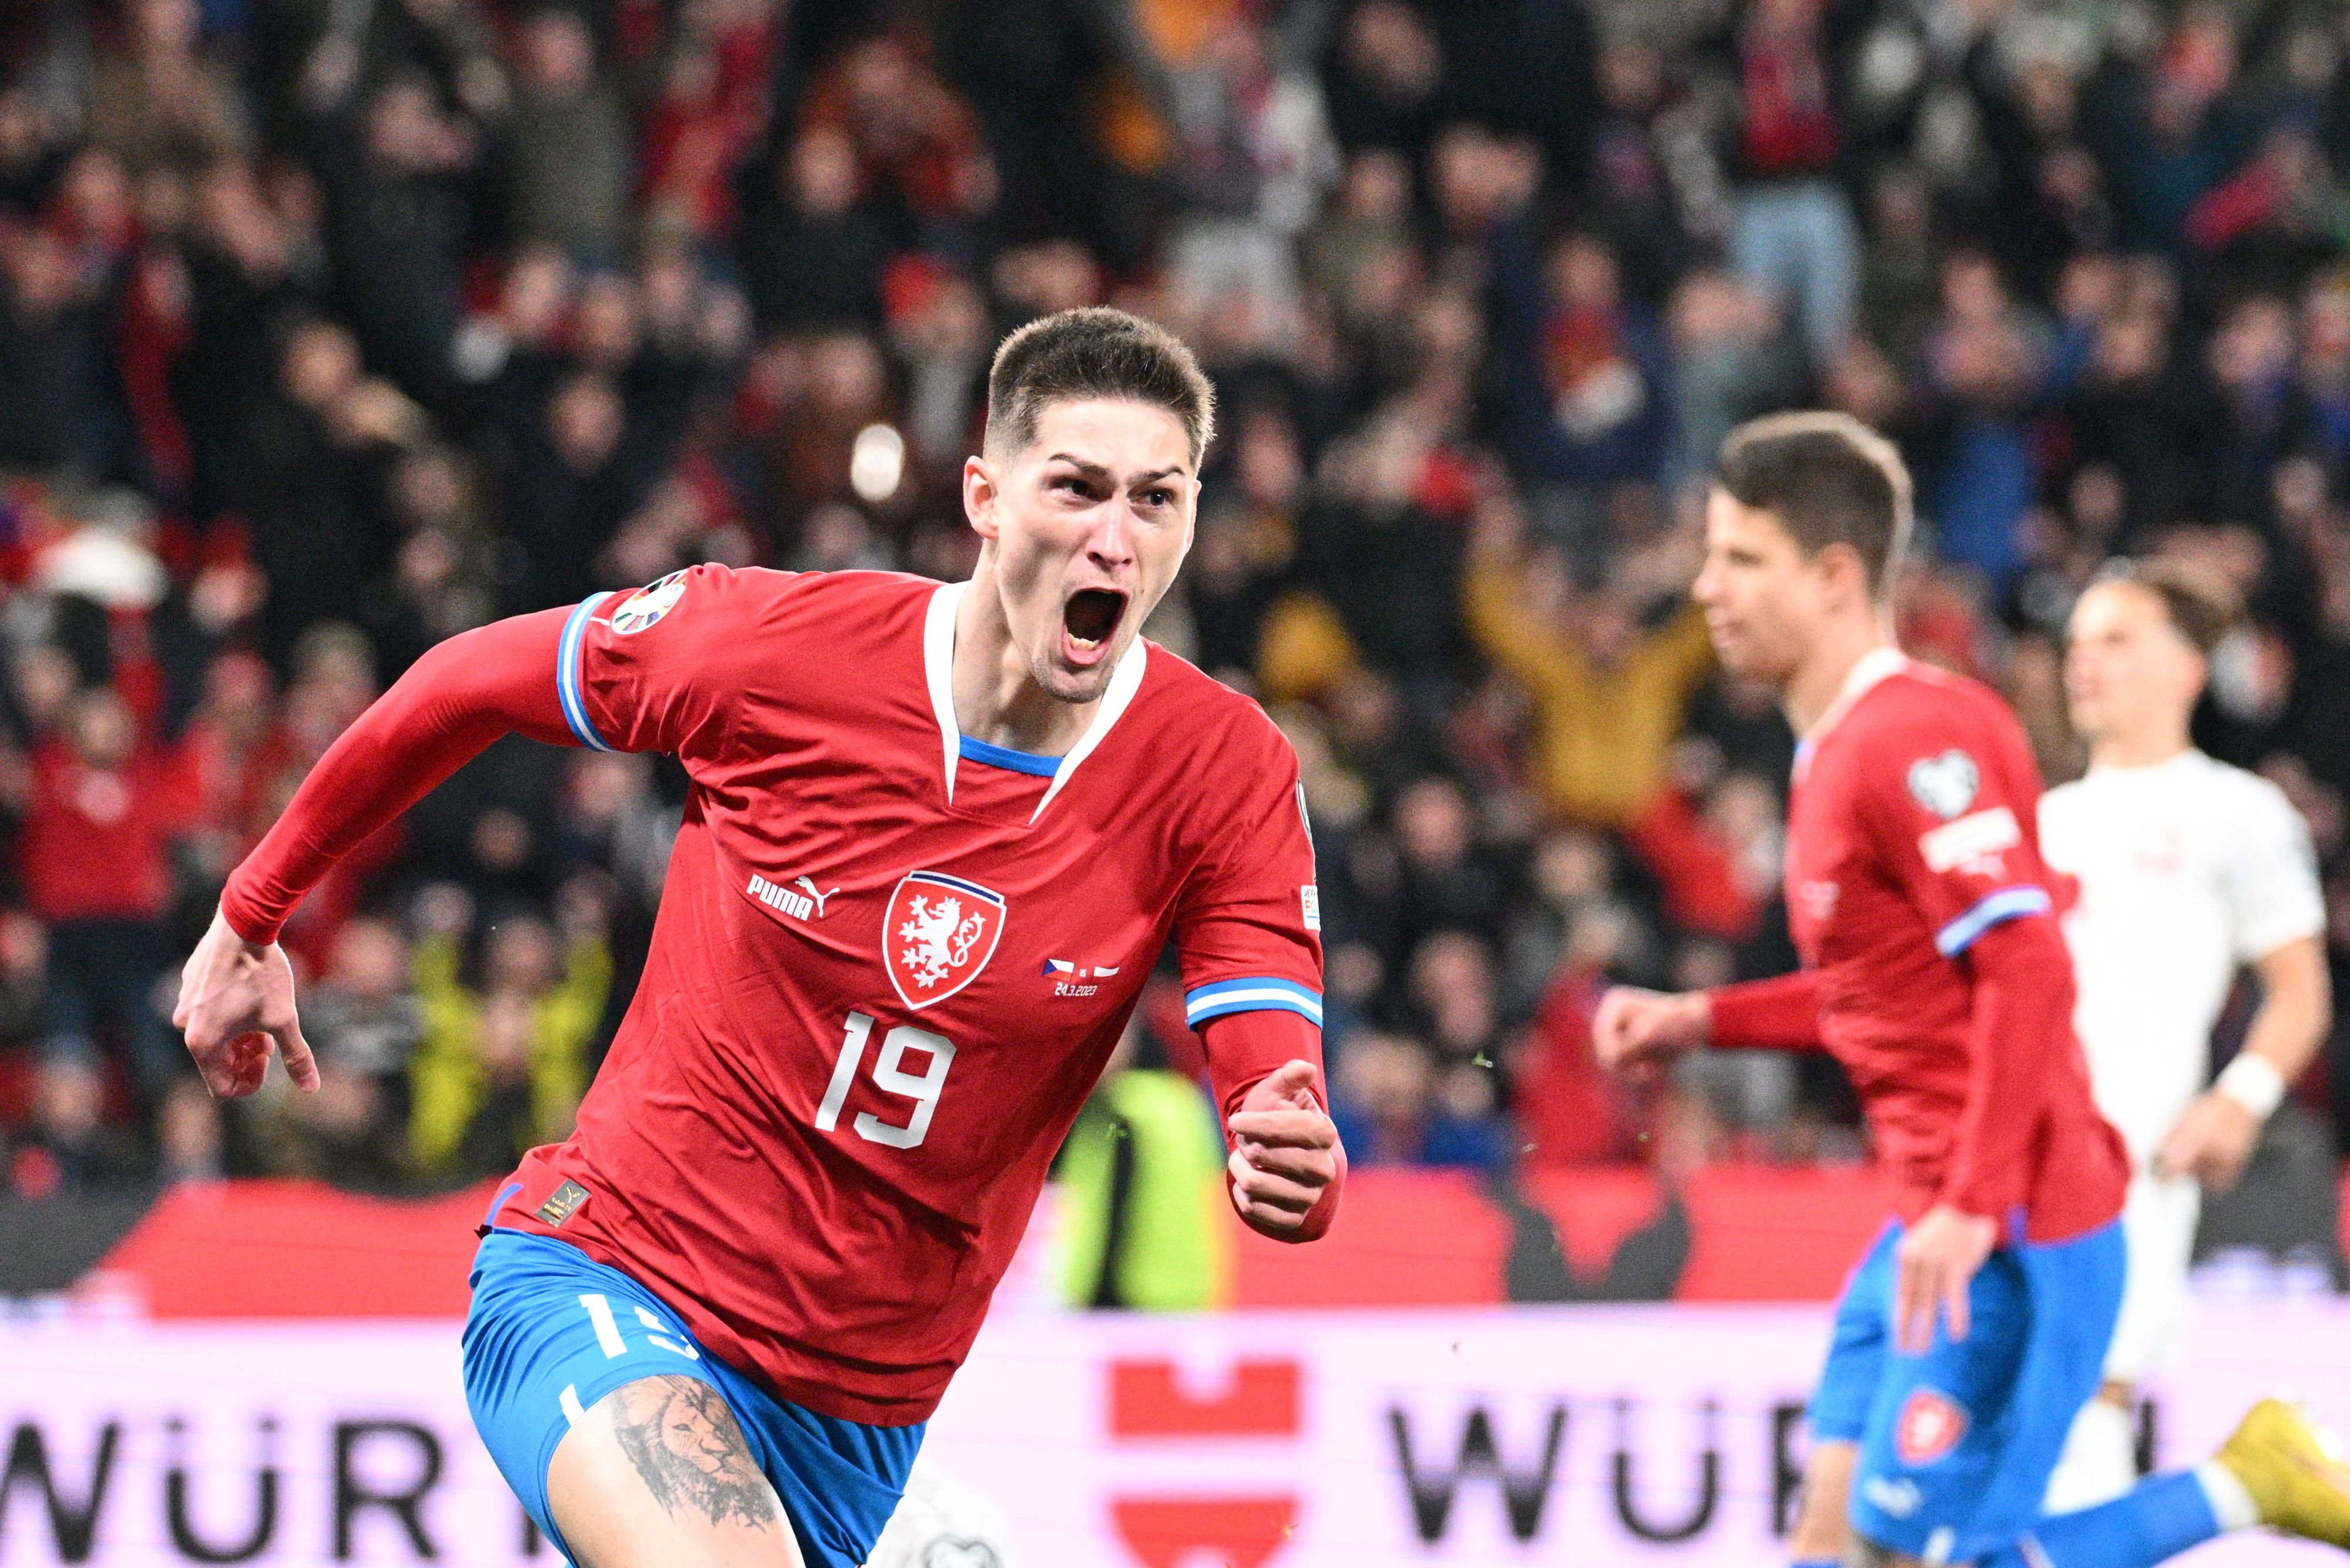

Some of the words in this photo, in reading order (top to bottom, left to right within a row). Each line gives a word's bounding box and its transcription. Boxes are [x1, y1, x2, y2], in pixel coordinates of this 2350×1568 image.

[746, 874, 814, 921] PUMA
[1055, 982, 1097, 996] 24.3.2023
[815, 1010, 957, 1149] 19
[0, 1418, 542, 1566] WÜR
